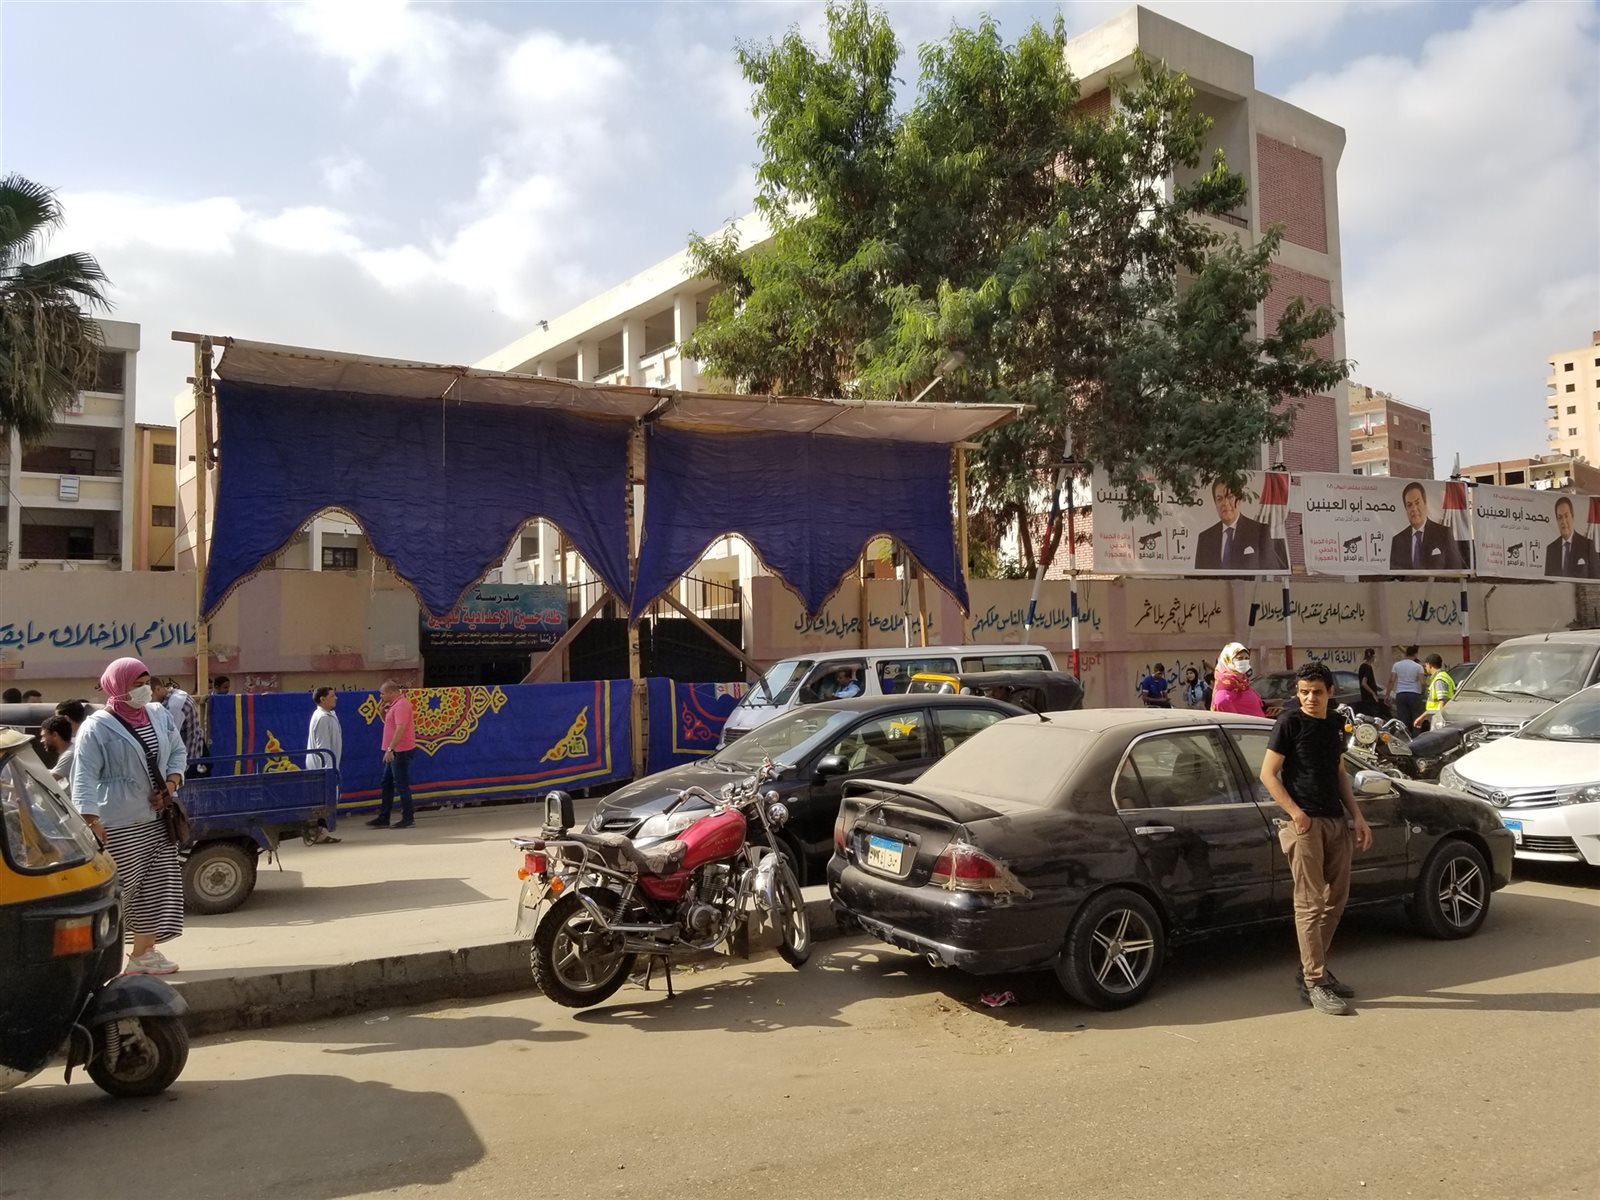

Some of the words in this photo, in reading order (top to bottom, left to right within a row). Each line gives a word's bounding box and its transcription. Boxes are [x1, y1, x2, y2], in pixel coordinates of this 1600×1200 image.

[1306, 497, 1347, 513] العينين
[1349, 496, 1363, 513] أبو
[1365, 501, 1396, 513] محمد
[1476, 504, 1511, 520] العينين
[1512, 506, 1523, 522] أبو
[1525, 512, 1550, 524] محمد
[1172, 526, 1189, 540] رقم
[1370, 530, 1384, 543] رقم
[475, 589, 520, 604] مدرسة
[513, 606, 542, 630] حسين
[1069, 607, 1102, 631] بالعل
[0, 623, 25, 650] بق
[49, 619, 136, 651] الأخلاق
[1066, 653, 1102, 671] Eypt
[1334, 649, 1357, 663] اللغة
